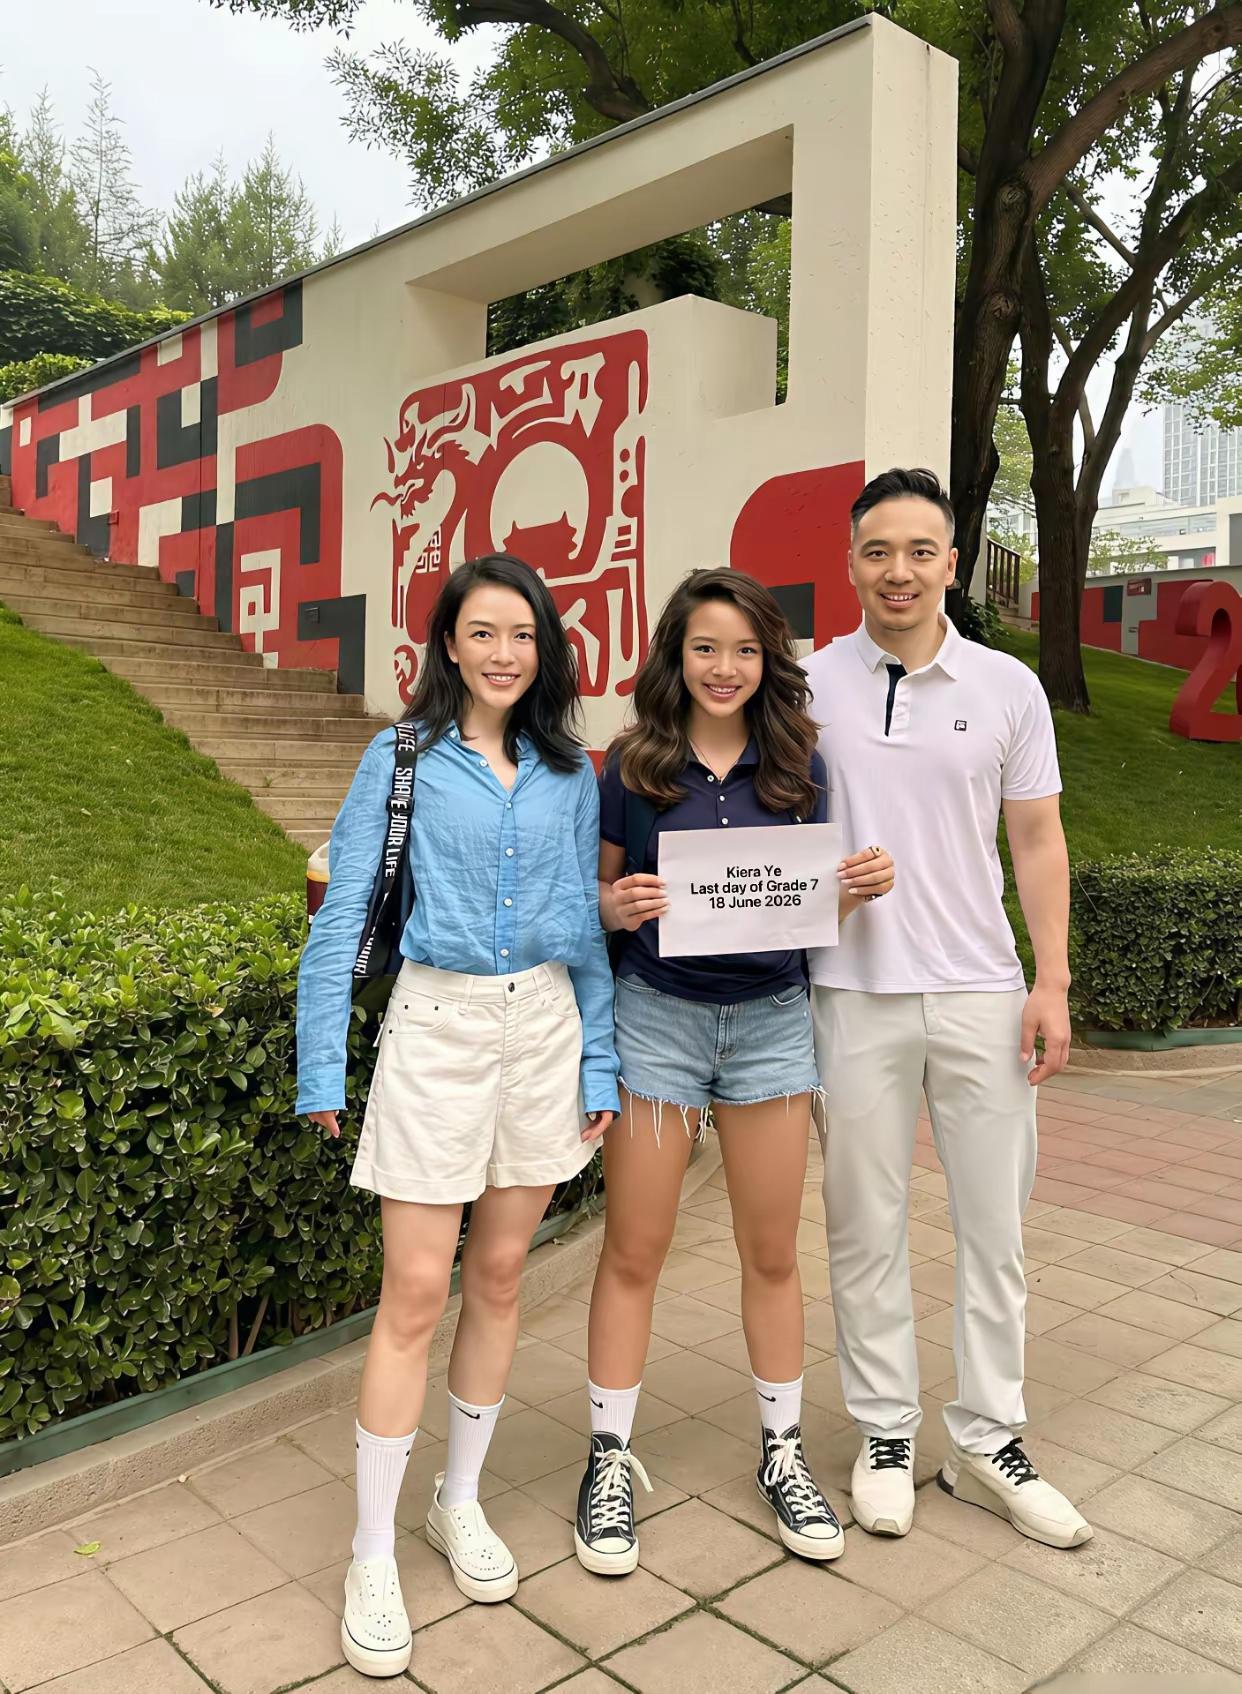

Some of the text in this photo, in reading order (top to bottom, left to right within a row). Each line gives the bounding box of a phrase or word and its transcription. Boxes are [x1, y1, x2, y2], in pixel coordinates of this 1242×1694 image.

[1169, 580, 1242, 742] 2
[387, 812, 408, 846] YOUR
[385, 849, 401, 878] LIFE
[726, 864, 782, 879] Kiera Ye
[690, 878, 819, 895] Last day of Grade 7
[709, 894, 802, 909] 18 June 2026
